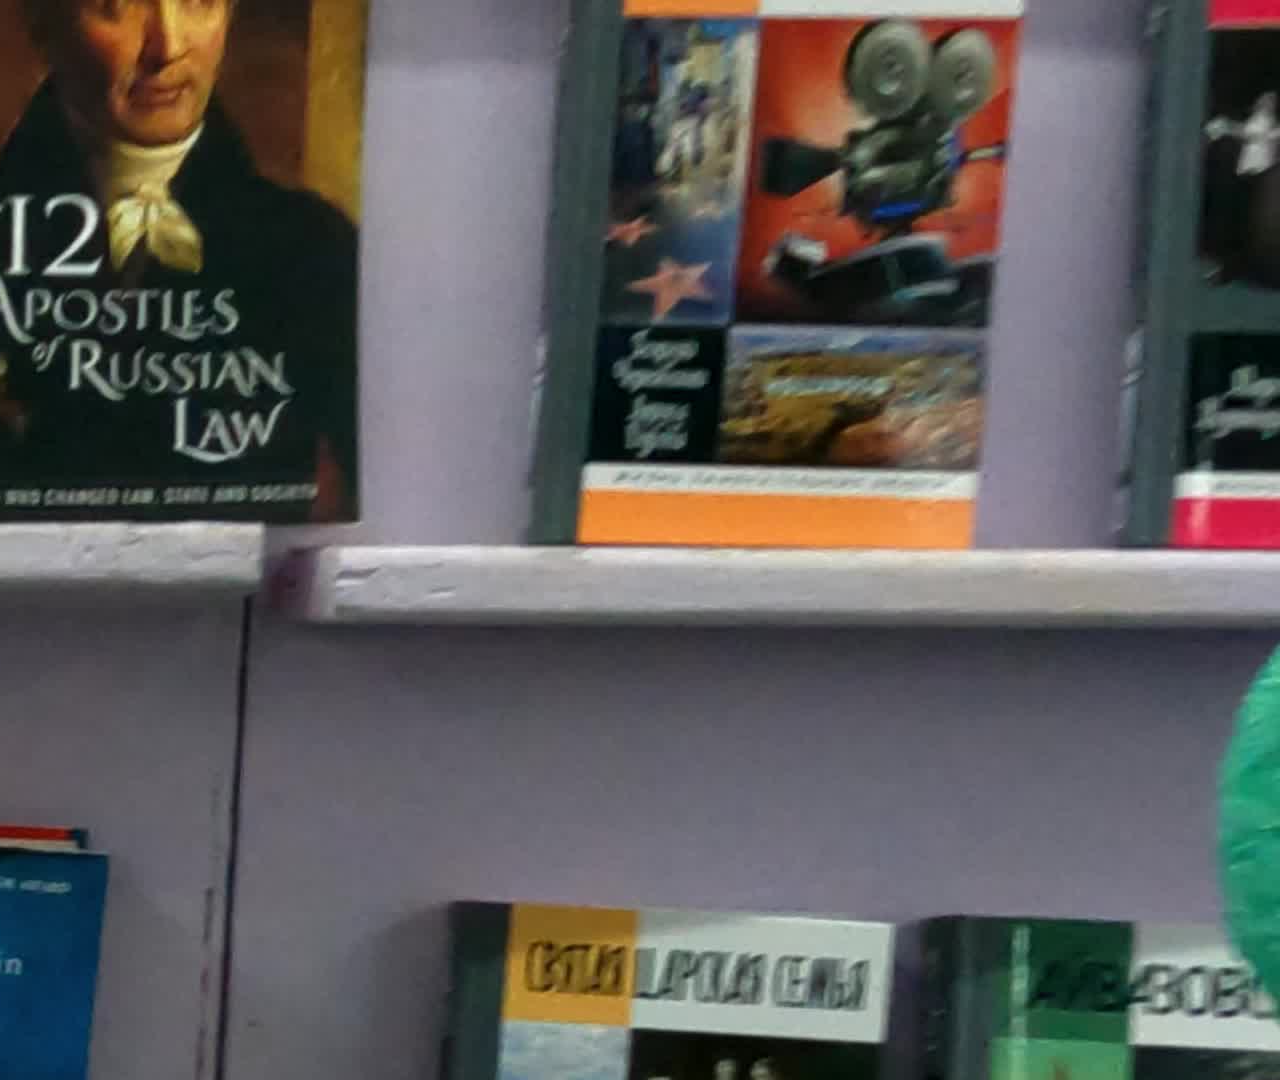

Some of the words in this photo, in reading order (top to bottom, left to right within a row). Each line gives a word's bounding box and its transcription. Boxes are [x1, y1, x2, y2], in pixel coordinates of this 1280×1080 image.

[5, 192, 104, 277] 12
[31, 334, 66, 373] of
[68, 338, 296, 402] RUSSIAN
[172, 397, 291, 463] LAW
